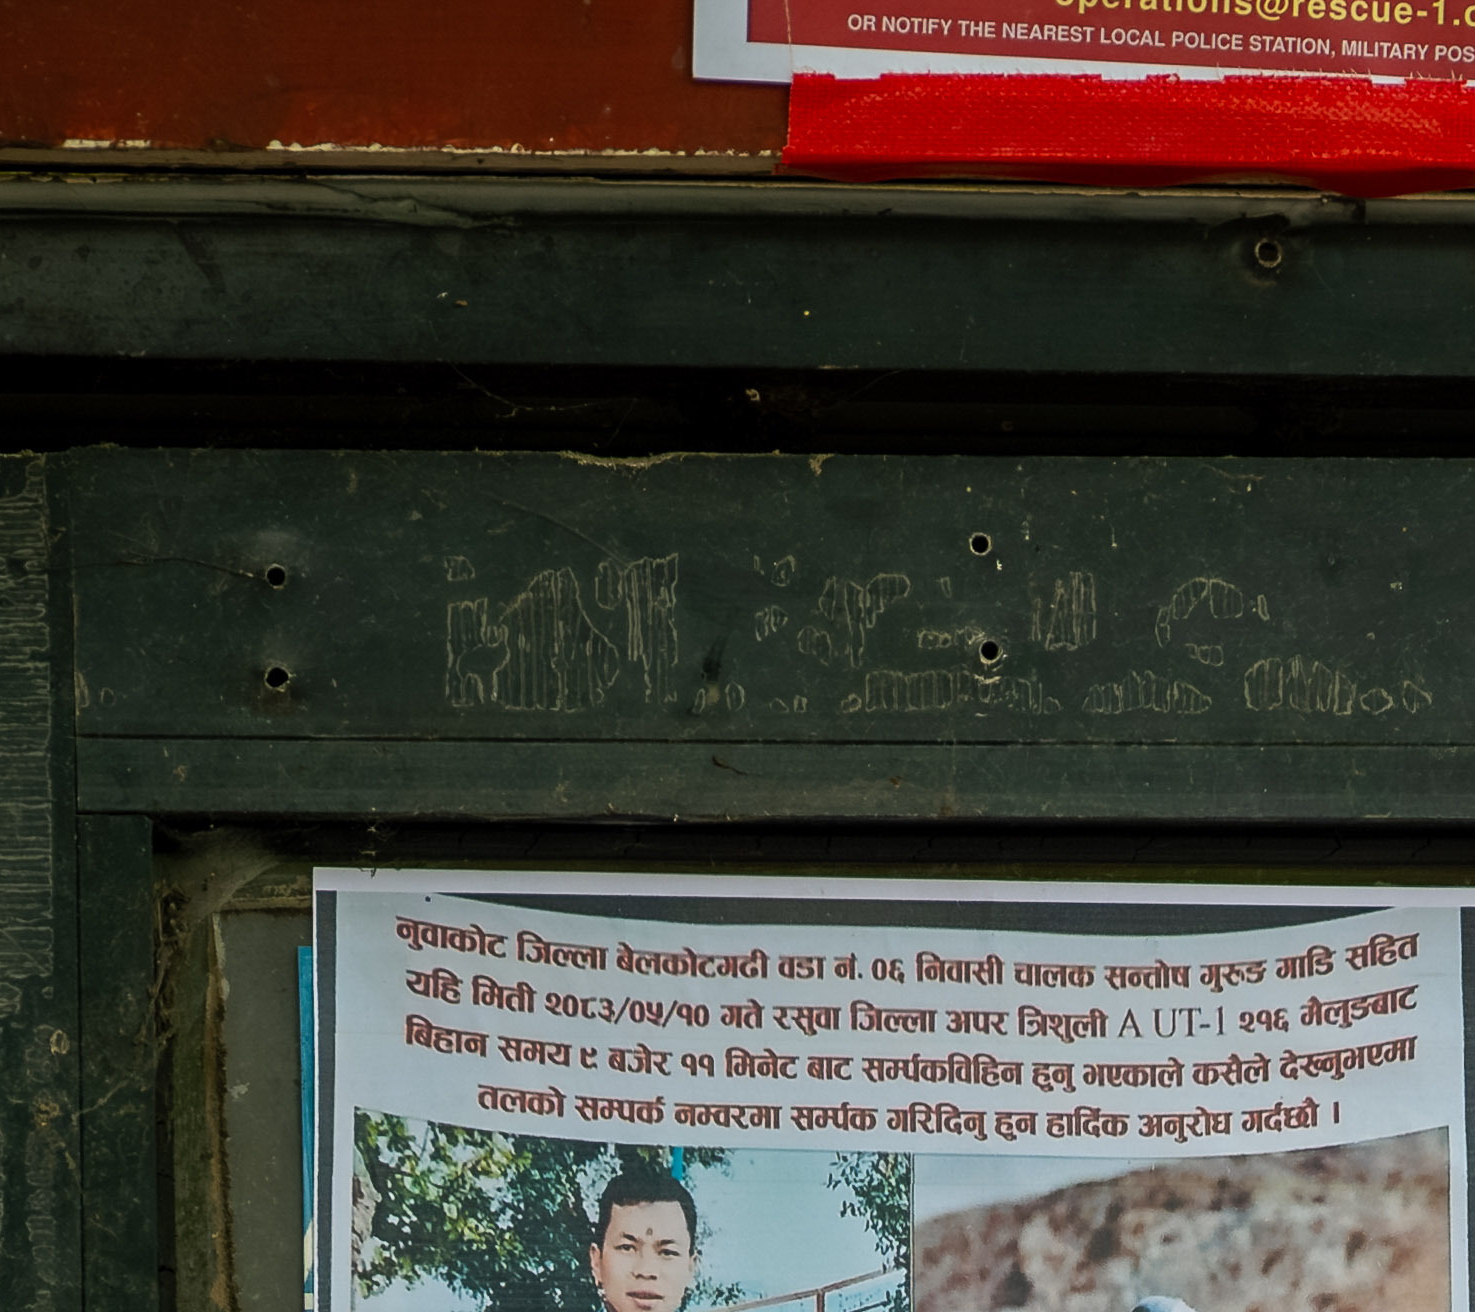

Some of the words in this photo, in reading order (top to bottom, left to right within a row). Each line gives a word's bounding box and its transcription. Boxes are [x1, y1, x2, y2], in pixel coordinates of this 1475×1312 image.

[847, 14, 876, 31] OR
[882, 16, 953, 36] NOTIFY
[958, 20, 996, 38] THE
[1002, 22, 1096, 43] NEAREST
[1100, 27, 1165, 47] LOCAL
[1171, 30, 1243, 51] POLICE
[1249, 33, 1335, 57] STATION,
[1341, 39, 1430, 60] MILITARY
[395, 915, 509, 959] नुवाकोट
[516, 930, 609, 971] जिल्ला
[778, 953, 826, 981] वडा
[871, 957, 905, 985] ०६
[915, 951, 1005, 987] निवासी
[1013, 962, 1097, 989] चालक
[1103, 957, 1192, 992] सन्तोष
[1275, 944, 1337, 981] गाडि
[1345, 932, 1421, 971] सहित
[405, 966, 463, 1005] यहि
[471, 973, 537, 1014] मिती
[544, 990, 710, 1028] २०८३/०५/१०
[720, 998, 765, 1030] गते
[773, 1005, 842, 1037] रसुवा
[849, 999, 938, 1033] जिल्ला
[945, 1010, 1009, 1036] अपर
[1017, 1005, 1109, 1044] त्रिशुली
[1239, 1008, 1289, 1034] २१६
[404, 1013, 489, 1059] बिहान
[497, 1034, 572, 1068] समय
[608, 1042, 673, 1077] बजेर
[681, 1052, 715, 1078] ११
[725, 1046, 799, 1080] मिनेट
[807, 1056, 854, 1081] बाट
[1031, 1062, 1076, 1093] हुनु
[1083, 1056, 1186, 1088] भएकाले
[1192, 1052, 1271, 1087] कसैले
[477, 1083, 567, 1119] तलको
[574, 1095, 666, 1125] सम्पर्क
[886, 1101, 988, 1141] गरिदिनु
[994, 1111, 1038, 1142] हुन
[1046, 1105, 1130, 1139] हार्दिक
[1138, 1105, 1232, 1144] अनुरोध
